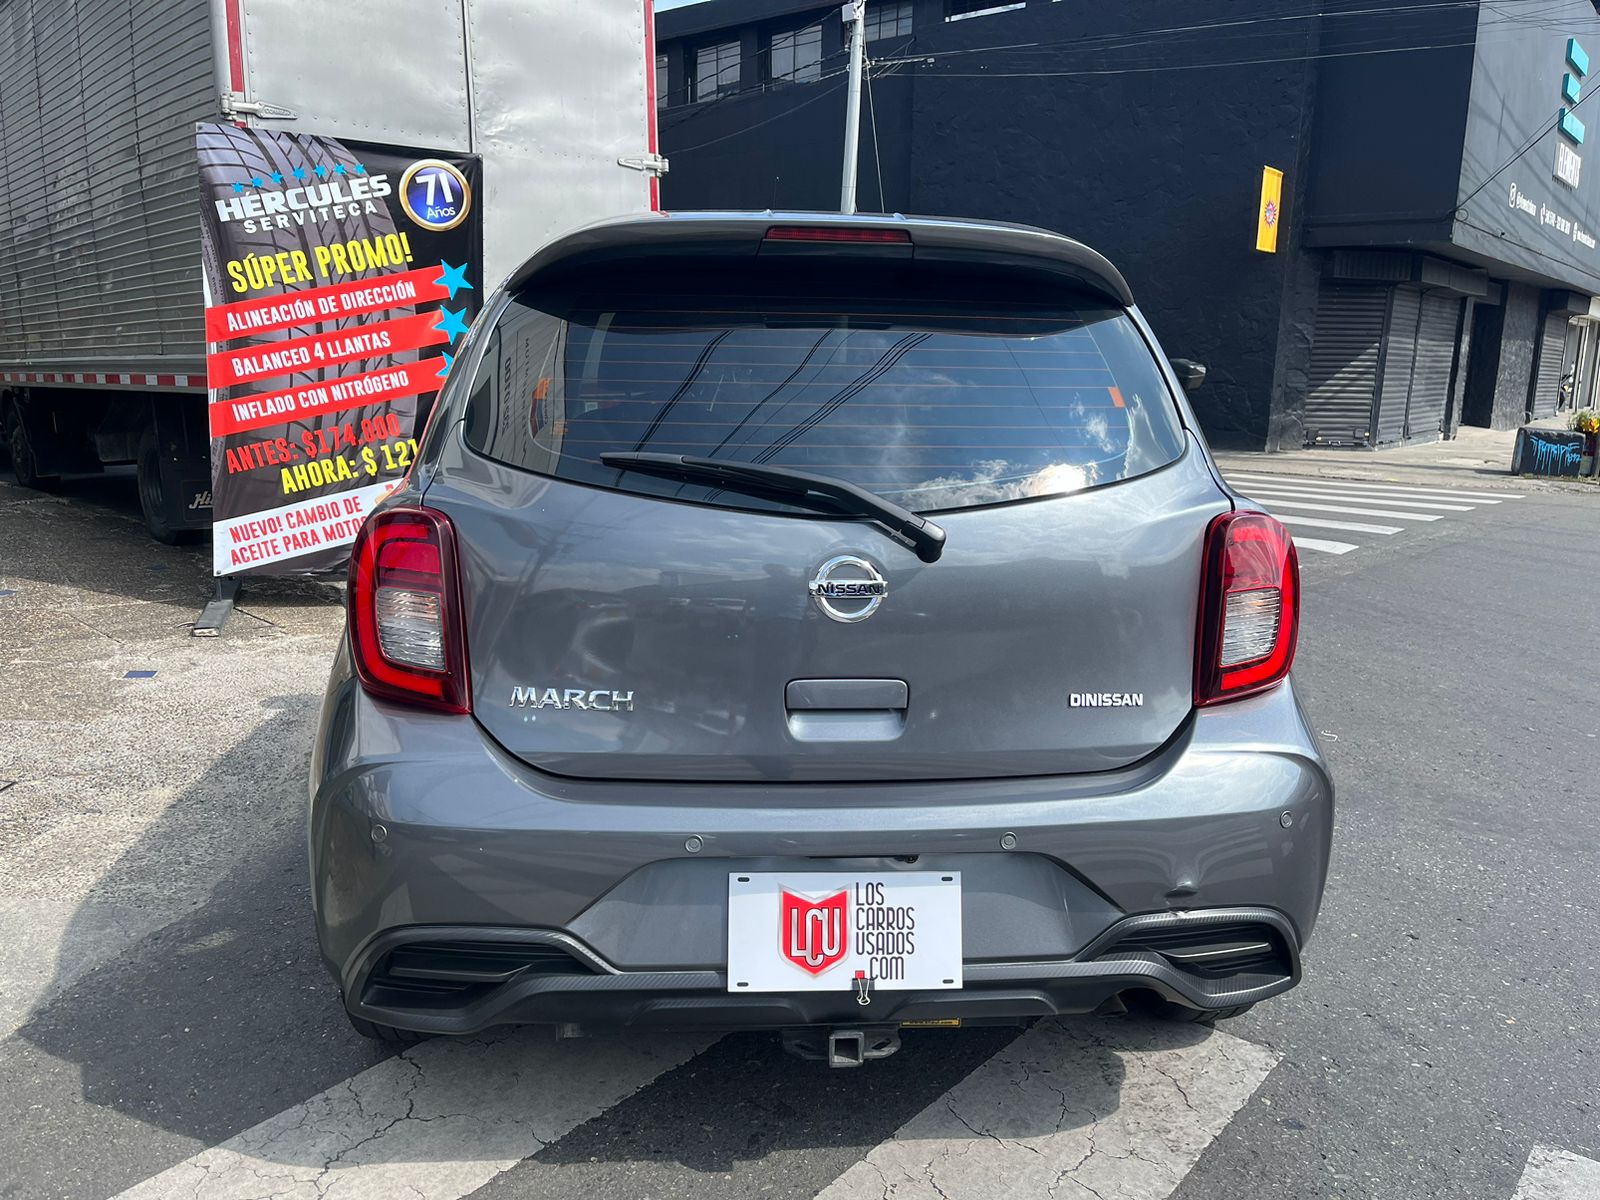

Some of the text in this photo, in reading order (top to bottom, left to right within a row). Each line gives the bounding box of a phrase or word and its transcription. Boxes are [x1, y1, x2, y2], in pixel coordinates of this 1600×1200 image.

[215, 174, 392, 223] HÉRCULES
[415, 172, 454, 206] 71
[244, 200, 378, 234] SERVITECA
[426, 206, 456, 220] Años
[226, 250, 313, 294] SÚPER
[314, 232, 414, 279] PROMO!
[227, 280, 417, 332] ALINEACIÓN DE DIRECCIÓN
[231, 331, 392, 378] BALANCEO 4 LLANTAS
[231, 370, 410, 423] INFLADO CON NITRÓGENO
[226, 412, 401, 474] ANTES: $174.000
[280, 454, 360, 495] AHORA:
[229, 496, 363, 544] NUEVO! CAMBIO DE
[230, 515, 368, 567] ACEITE PARA MOTO
[817, 582, 883, 596] NISSAN
[508, 685, 635, 712] MARCH
[1068, 693, 1144, 708] DINISSAN
[855, 882, 885, 907] LOS
[790, 906, 842, 968] LCU
[855, 906, 916, 931] CARROS
[855, 931, 916, 956] USADOS
